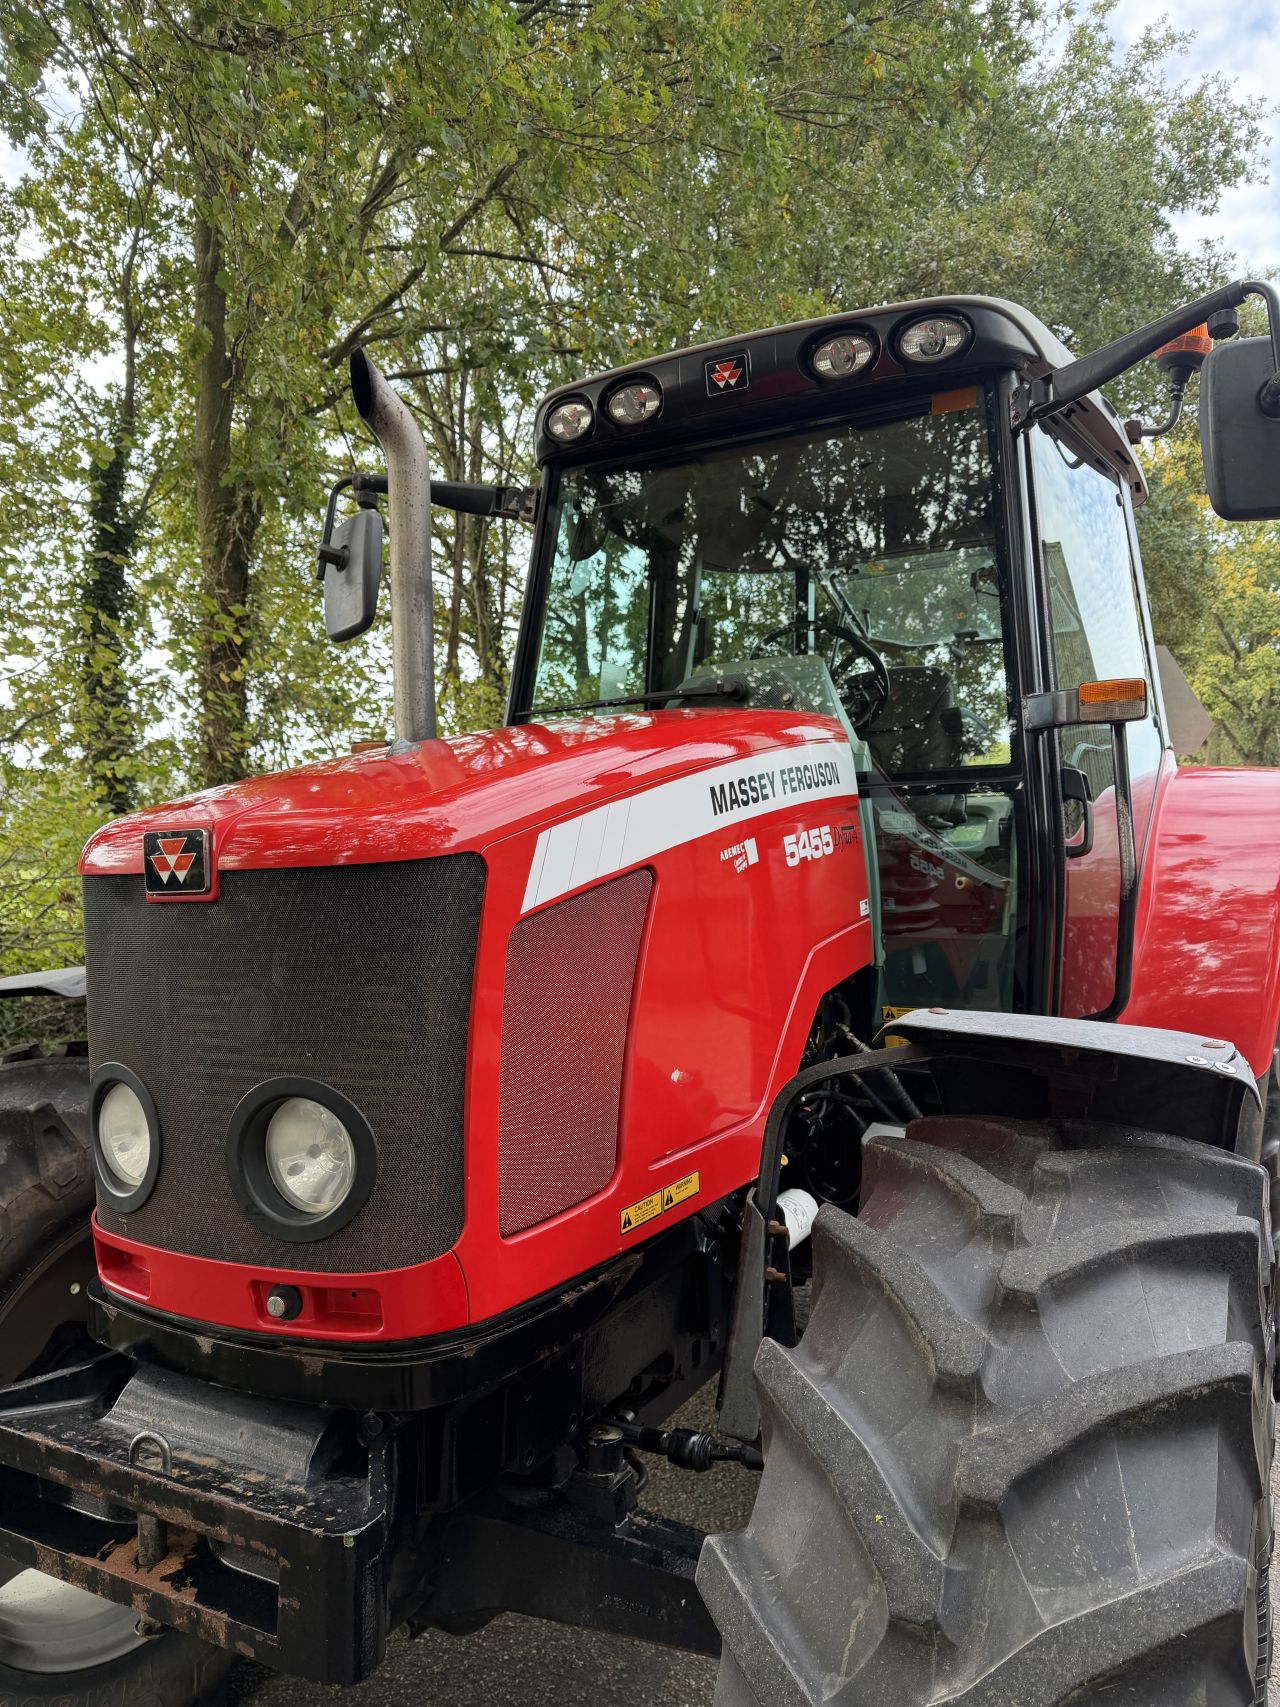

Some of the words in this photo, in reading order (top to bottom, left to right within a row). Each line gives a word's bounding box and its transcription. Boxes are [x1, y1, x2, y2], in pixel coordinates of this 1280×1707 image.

[709, 771, 776, 815] MASSEY
[780, 762, 840, 795] FERGUSON
[784, 825, 834, 867] 5455
[634, 1198, 654, 1212] CAUTION
